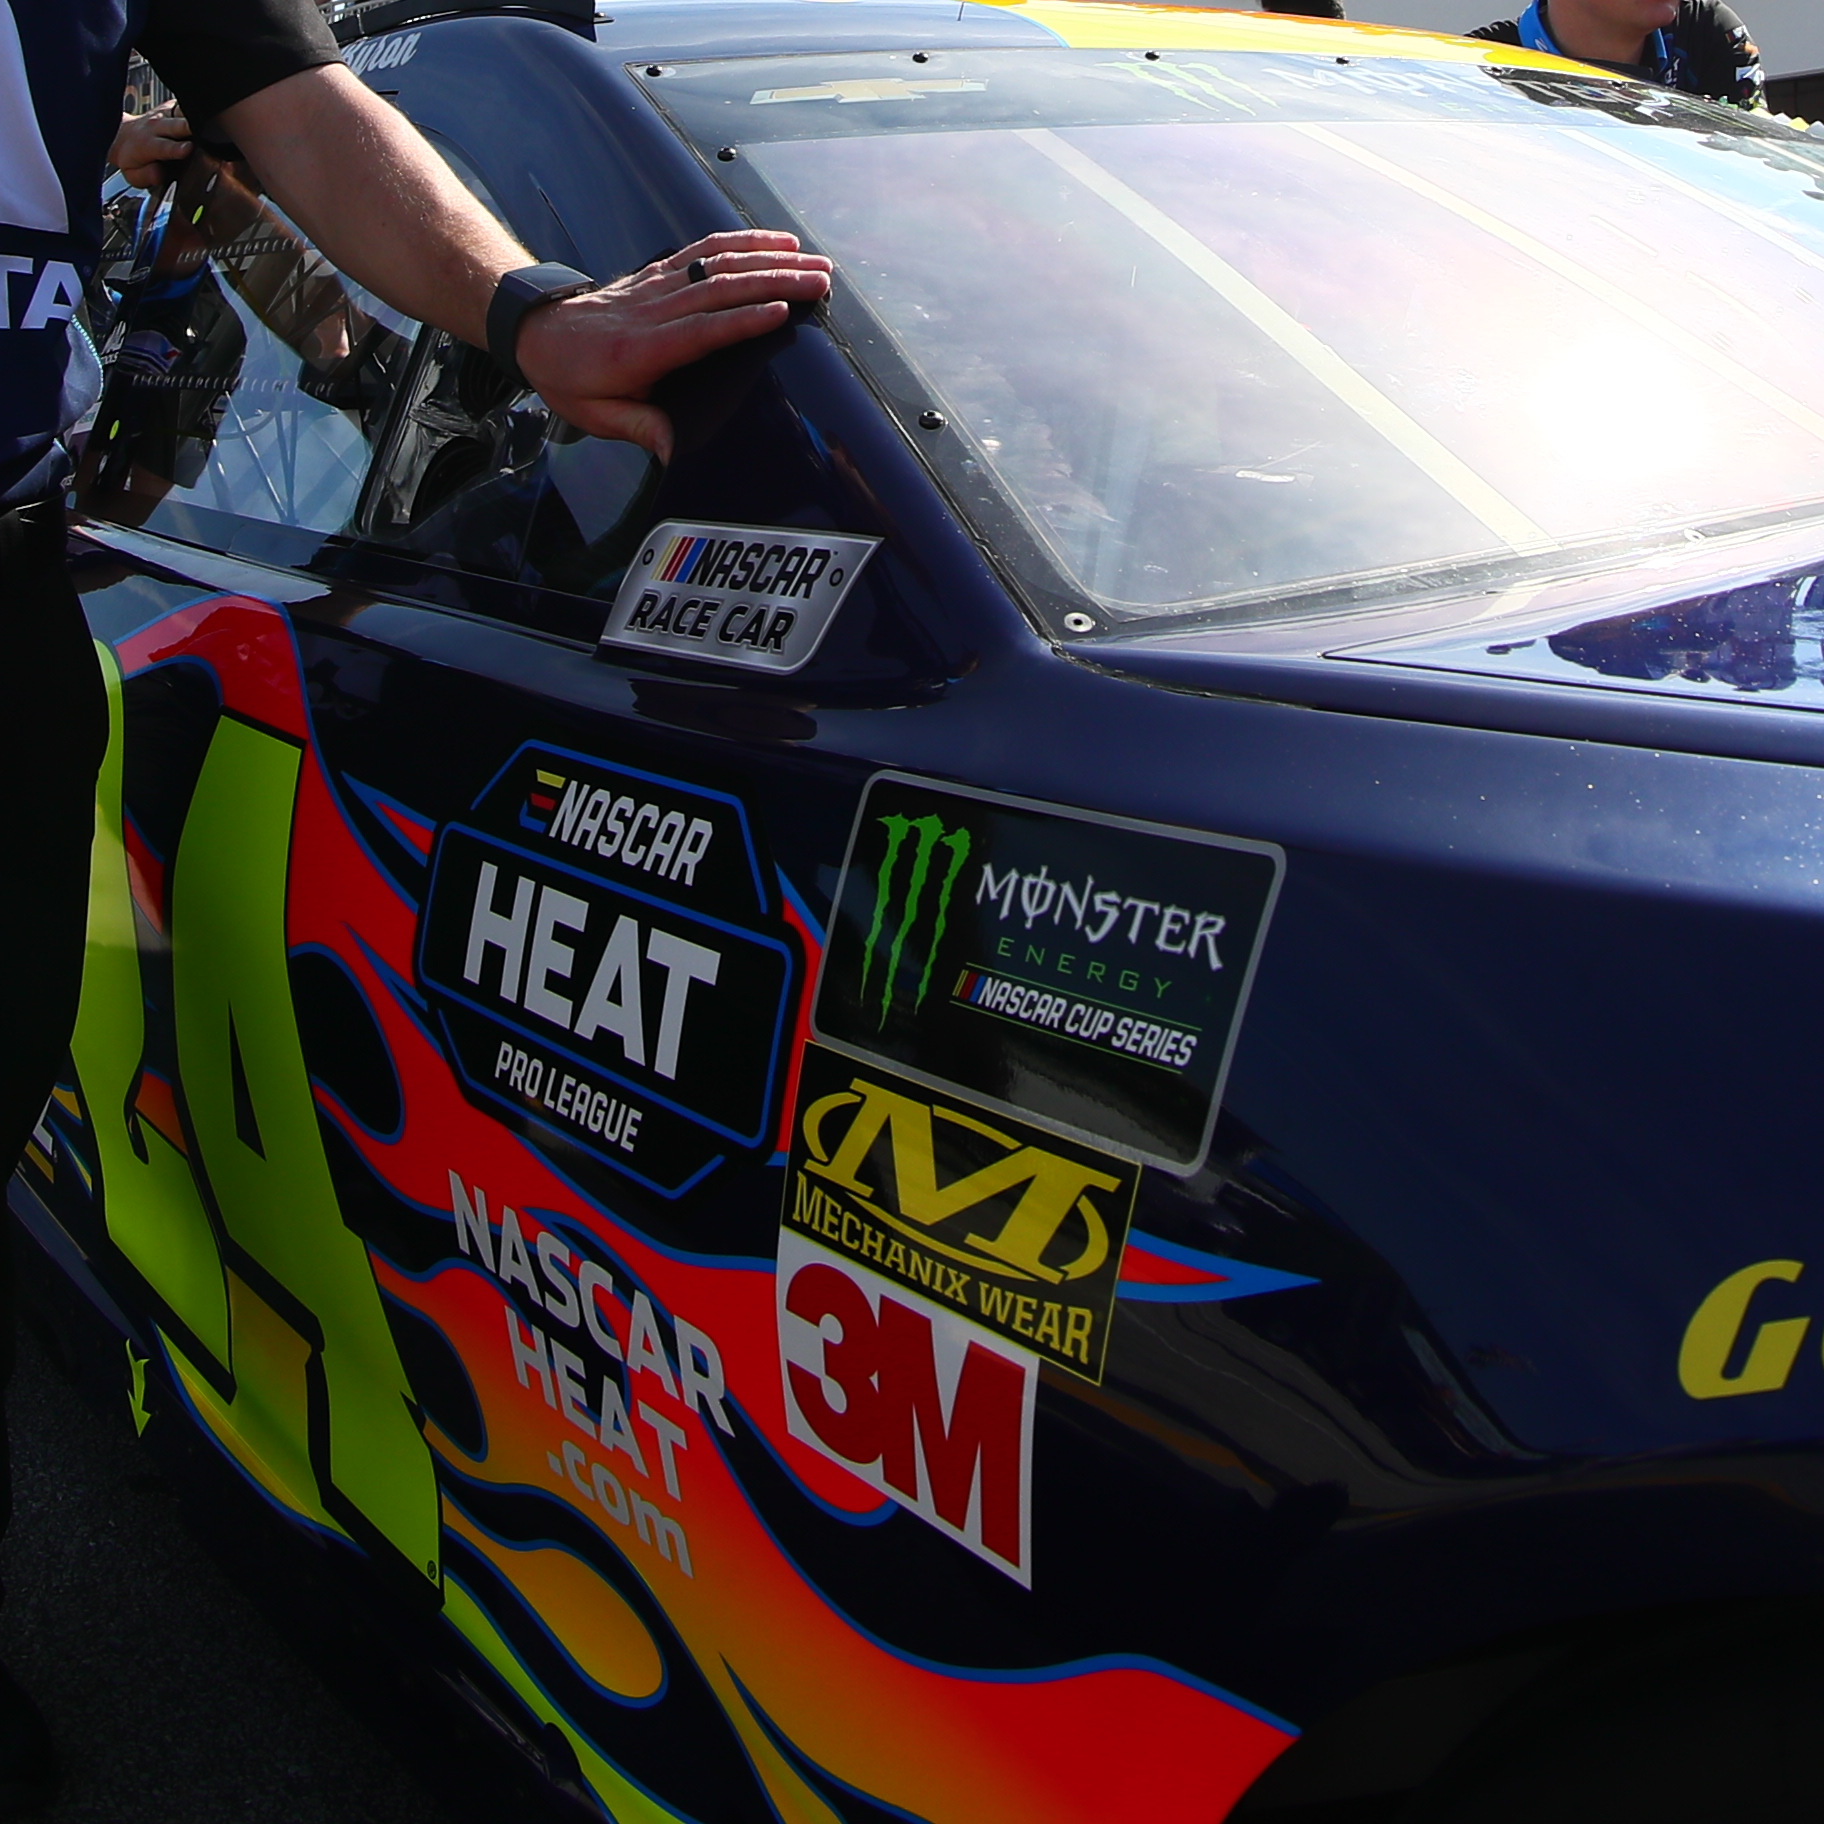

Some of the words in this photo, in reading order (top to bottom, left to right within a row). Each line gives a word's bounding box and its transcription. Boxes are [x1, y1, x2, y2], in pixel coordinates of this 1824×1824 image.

[627, 589, 721, 638] RACE
[718, 604, 796, 652] CAR
[686, 538, 832, 599] NASCAR
[463, 860, 721, 1081] HEAT
[975, 863, 1226, 971] MONSTER
[996, 937, 1173, 999] ENERGY
[977, 976, 1064, 1034] NASCAR
[1063, 1002, 1113, 1042] CUP
[1111, 1017, 1197, 1067] SERIES
[494, 1040, 543, 1099] PRO
[543, 1067, 643, 1153] LEAGUE
[448, 1168, 736, 1438] NASCAR
[791, 1169, 972, 1305] MECHANIX
[978, 1280, 1094, 1366] WEAR
[504, 1304, 689, 1502] HEAT
[785, 1262, 1026, 1570] 3M
[546, 1439, 694, 1580] .com
